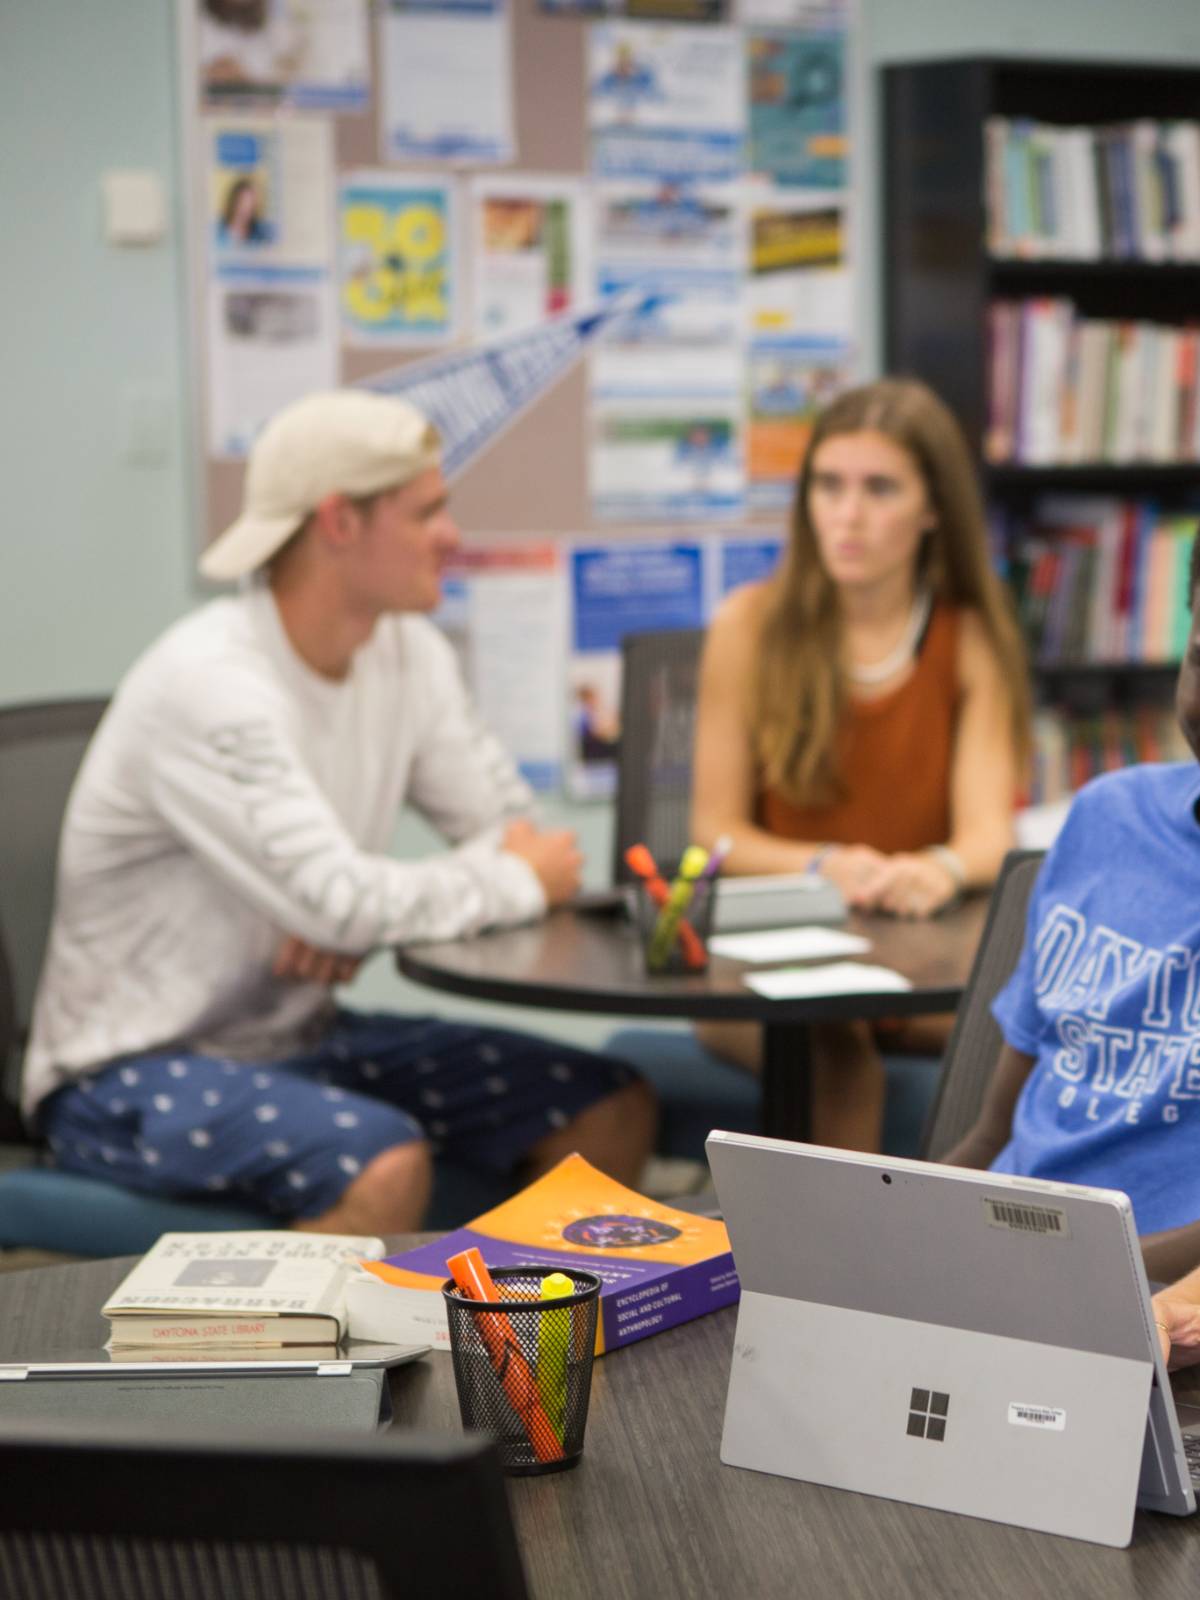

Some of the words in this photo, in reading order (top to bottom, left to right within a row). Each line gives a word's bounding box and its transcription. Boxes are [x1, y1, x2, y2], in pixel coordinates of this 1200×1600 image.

[616, 1285, 660, 1308] ENCYCLOPEDIA
[660, 1281, 669, 1292] OF
[617, 1309, 639, 1322] SOCIAL
[640, 1303, 653, 1313] AND
[652, 1292, 683, 1309] CULTURAL
[152, 1327, 199, 1338] DAYTONA
[201, 1325, 229, 1336] STATE
[232, 1323, 266, 1334] LIBRARY
[619, 1314, 663, 1336] ANTHROPOLOGY
